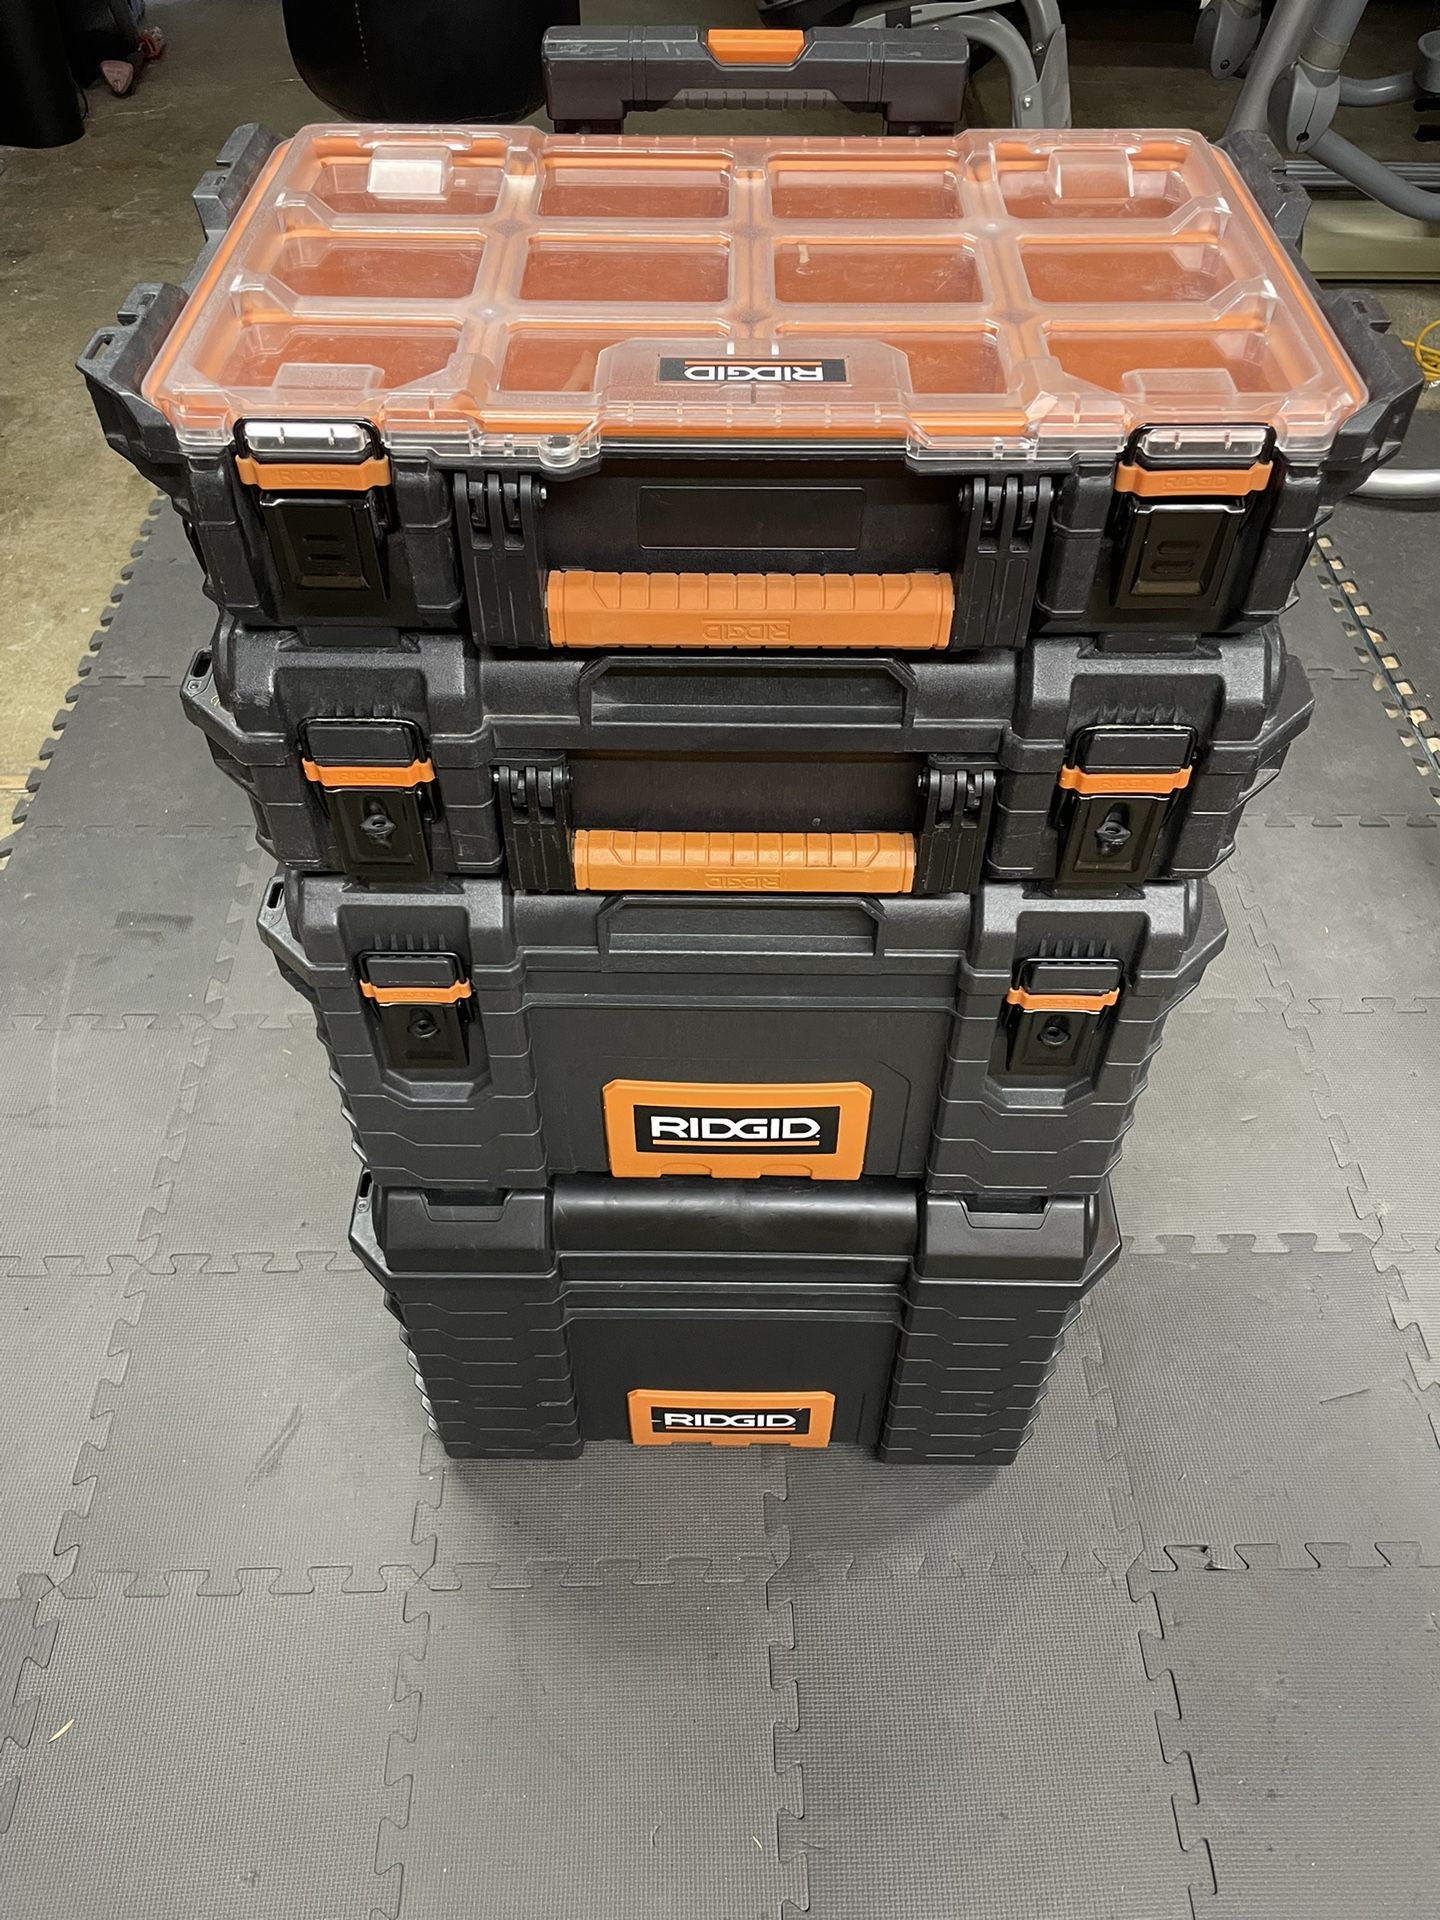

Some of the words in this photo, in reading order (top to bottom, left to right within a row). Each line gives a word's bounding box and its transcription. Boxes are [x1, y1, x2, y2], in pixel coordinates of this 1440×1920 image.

[683, 365, 824, 382] RIDGID
[702, 623, 791, 641] RIDGID
[704, 876, 781, 889] RIDGID
[663, 1412, 797, 1428] RIDGID
